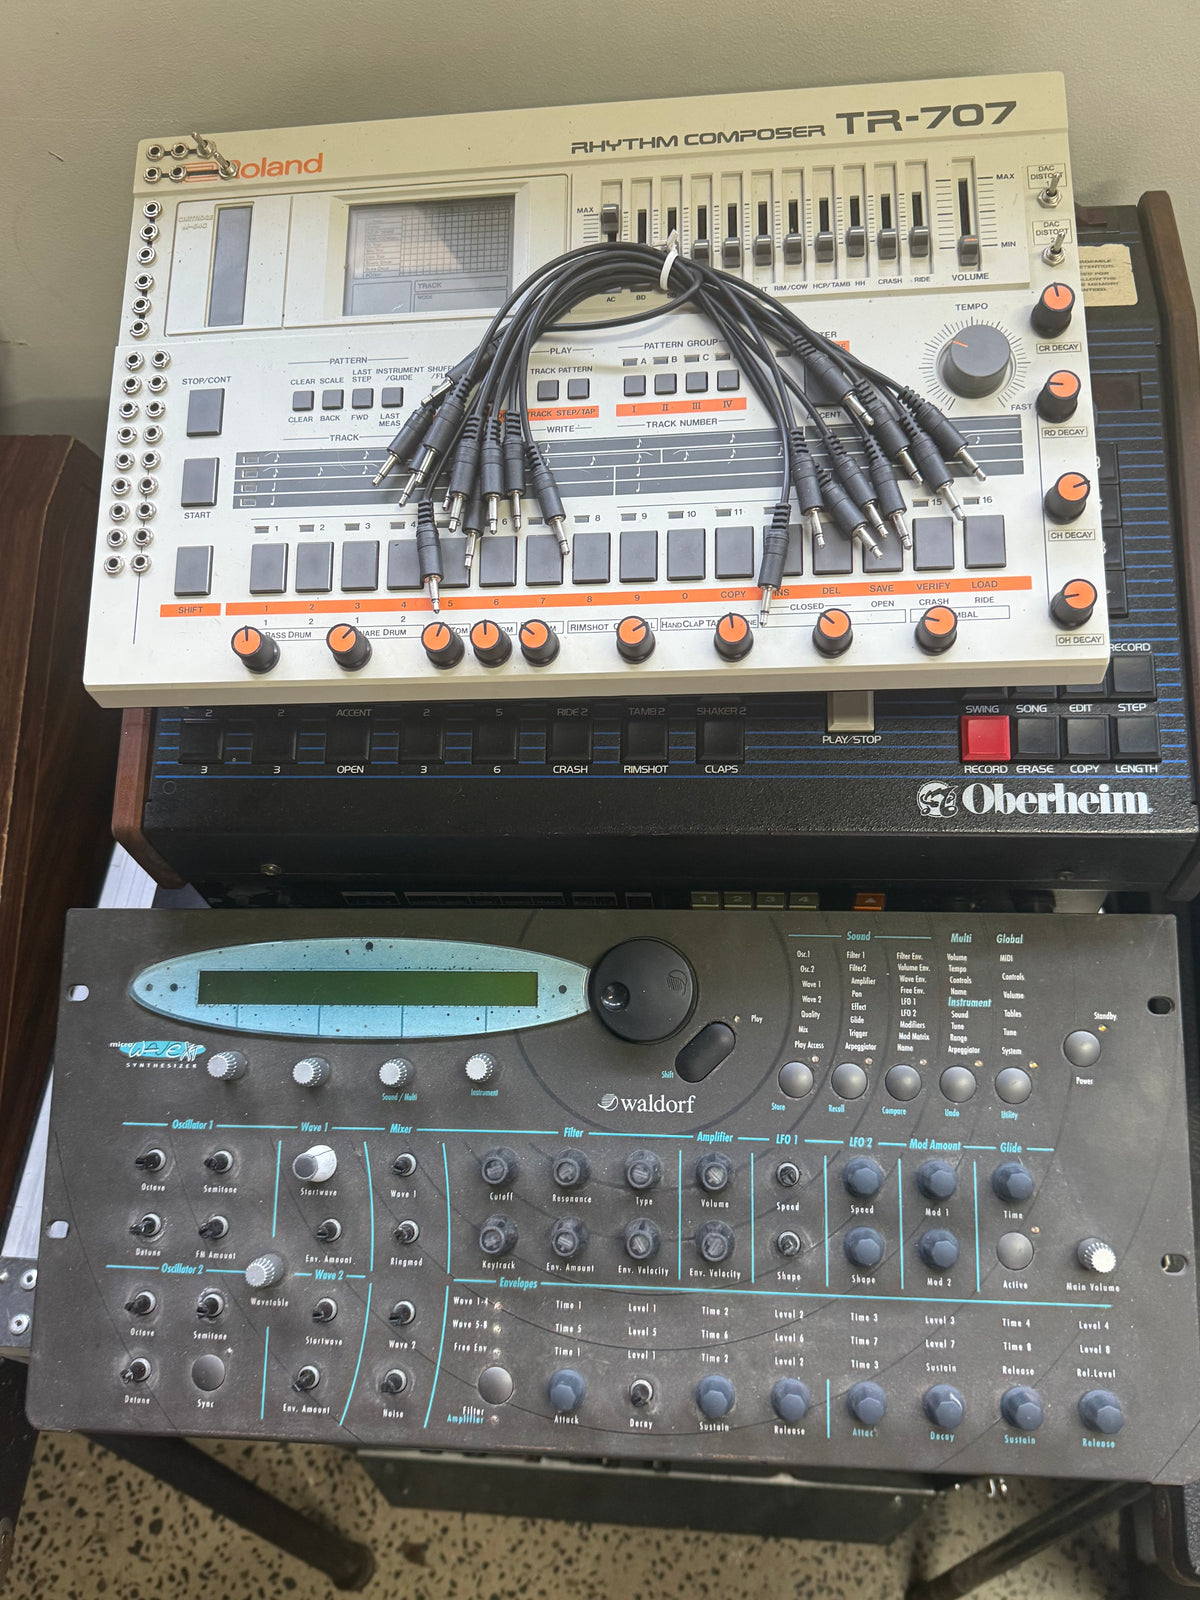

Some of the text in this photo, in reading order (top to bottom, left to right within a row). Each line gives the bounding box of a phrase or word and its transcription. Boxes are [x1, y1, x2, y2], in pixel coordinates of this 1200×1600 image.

[836, 101, 1017, 134] TR-707
[572, 125, 825, 154] RHYTHM COMPOSER
[952, 273, 989, 281] VOLUME
[955, 302, 988, 311] TEMPO
[644, 341, 683, 349] PATTERN
[1051, 343, 1079, 351] DECAY
[531, 367, 556, 375] TRACK
[558, 365, 592, 373] PATTERN
[182, 376, 231, 385] STOP/CONT
[1011, 403, 1032, 411] FAST
[556, 408, 595, 416] STEP/TAP
[647, 418, 717, 428] TRACK NUMBER
[547, 425, 574, 433] WRITE
[1064, 531, 1092, 539] DECAY
[916, 582, 950, 591] VERIFY
[720, 591, 746, 599] COPY
[178, 606, 203, 614] SHIFT
[790, 603, 824, 611] CLOSED
[570, 623, 608, 631] RIMSHOT
[1058, 635, 1101, 644] OH DECAY
[1109, 642, 1150, 652] RECORD
[697, 707, 746, 715] SHAKER 2
[966, 705, 999, 713] SWING
[1016, 704, 1047, 713] SONG
[1069, 704, 1093, 712] EDIT
[1118, 703, 1146, 712] STEP
[822, 736, 881, 744] PLAY/STOP
[337, 766, 364, 774] OPEN
[704, 765, 738, 773] CLAPS
[964, 765, 1008, 773] RECORD
[1016, 765, 1053, 773] ERASE
[1070, 765, 1099, 773] COPY
[1115, 764, 1158, 773] LENGTH
[962, 783, 1150, 814] Oberheim
[847, 931, 871, 940] Sound
[951, 933, 972, 943] Multi
[996, 934, 1023, 944] Global
[949, 965, 966, 973] Tempo
[851, 977, 876, 986] Amplifier
[948, 997, 991, 1007] Instrument
[801, 1011, 820, 1020] Quality
[1094, 1012, 1116, 1021] Standby
[849, 1029, 868, 1038] Trigger
[950, 1034, 967, 1043] Range
[795, 1041, 824, 1049] Play Access
[1002, 1047, 1022, 1055] System
[662, 1071, 674, 1079] Shift
[1076, 1077, 1093, 1085] Power
[471, 1088, 498, 1096] Instrument
[621, 1094, 695, 1114] waldorf
[771, 1103, 785, 1111] Store
[882, 1107, 906, 1116] Compare
[1001, 1111, 1018, 1120] Utility
[172, 1119, 205, 1129] Oscillator
[301, 1122, 321, 1132] Wave
[390, 1124, 412, 1134] Mixer
[563, 1127, 584, 1138] Filter
[697, 1131, 733, 1143] Amplifier
[910, 1139, 961, 1150] Mod Amount
[1000, 1142, 1022, 1153] Glide
[141, 1183, 165, 1191] Octave
[203, 1185, 237, 1193] Semitone
[300, 1187, 337, 1196] Startwave
[490, 1192, 513, 1201] Cutoff
[552, 1194, 592, 1203] Resonance
[636, 1197, 652, 1206] Type
[701, 1200, 729, 1208] Volume
[777, 1202, 799, 1211] Speed
[391, 1258, 422, 1267] Ringmod
[482, 1260, 515, 1269] Keytrack
[690, 1268, 741, 1280] Env. Velocity
[777, 1272, 801, 1281] Shape
[500, 1277, 538, 1289] Envelopes
[1003, 1280, 1028, 1290] Active
[1066, 1282, 1120, 1292] Main Volume
[250, 1297, 288, 1307] Wavetable
[1077, 1369, 1115, 1378] Rel.Level
[197, 1399, 214, 1409] Sync
[383, 1409, 403, 1418] Noise
[463, 1406, 484, 1415] Filter
[447, 1414, 484, 1424] Amplifier
[554, 1415, 578, 1424] Attack
[630, 1419, 652, 1429] Decay
[700, 1423, 729, 1432] Sustain
[774, 1426, 805, 1435] Release
[930, 1432, 954, 1442] Decay
[1005, 1435, 1035, 1444] Sustain
[1082, 1438, 1115, 1448] Release
